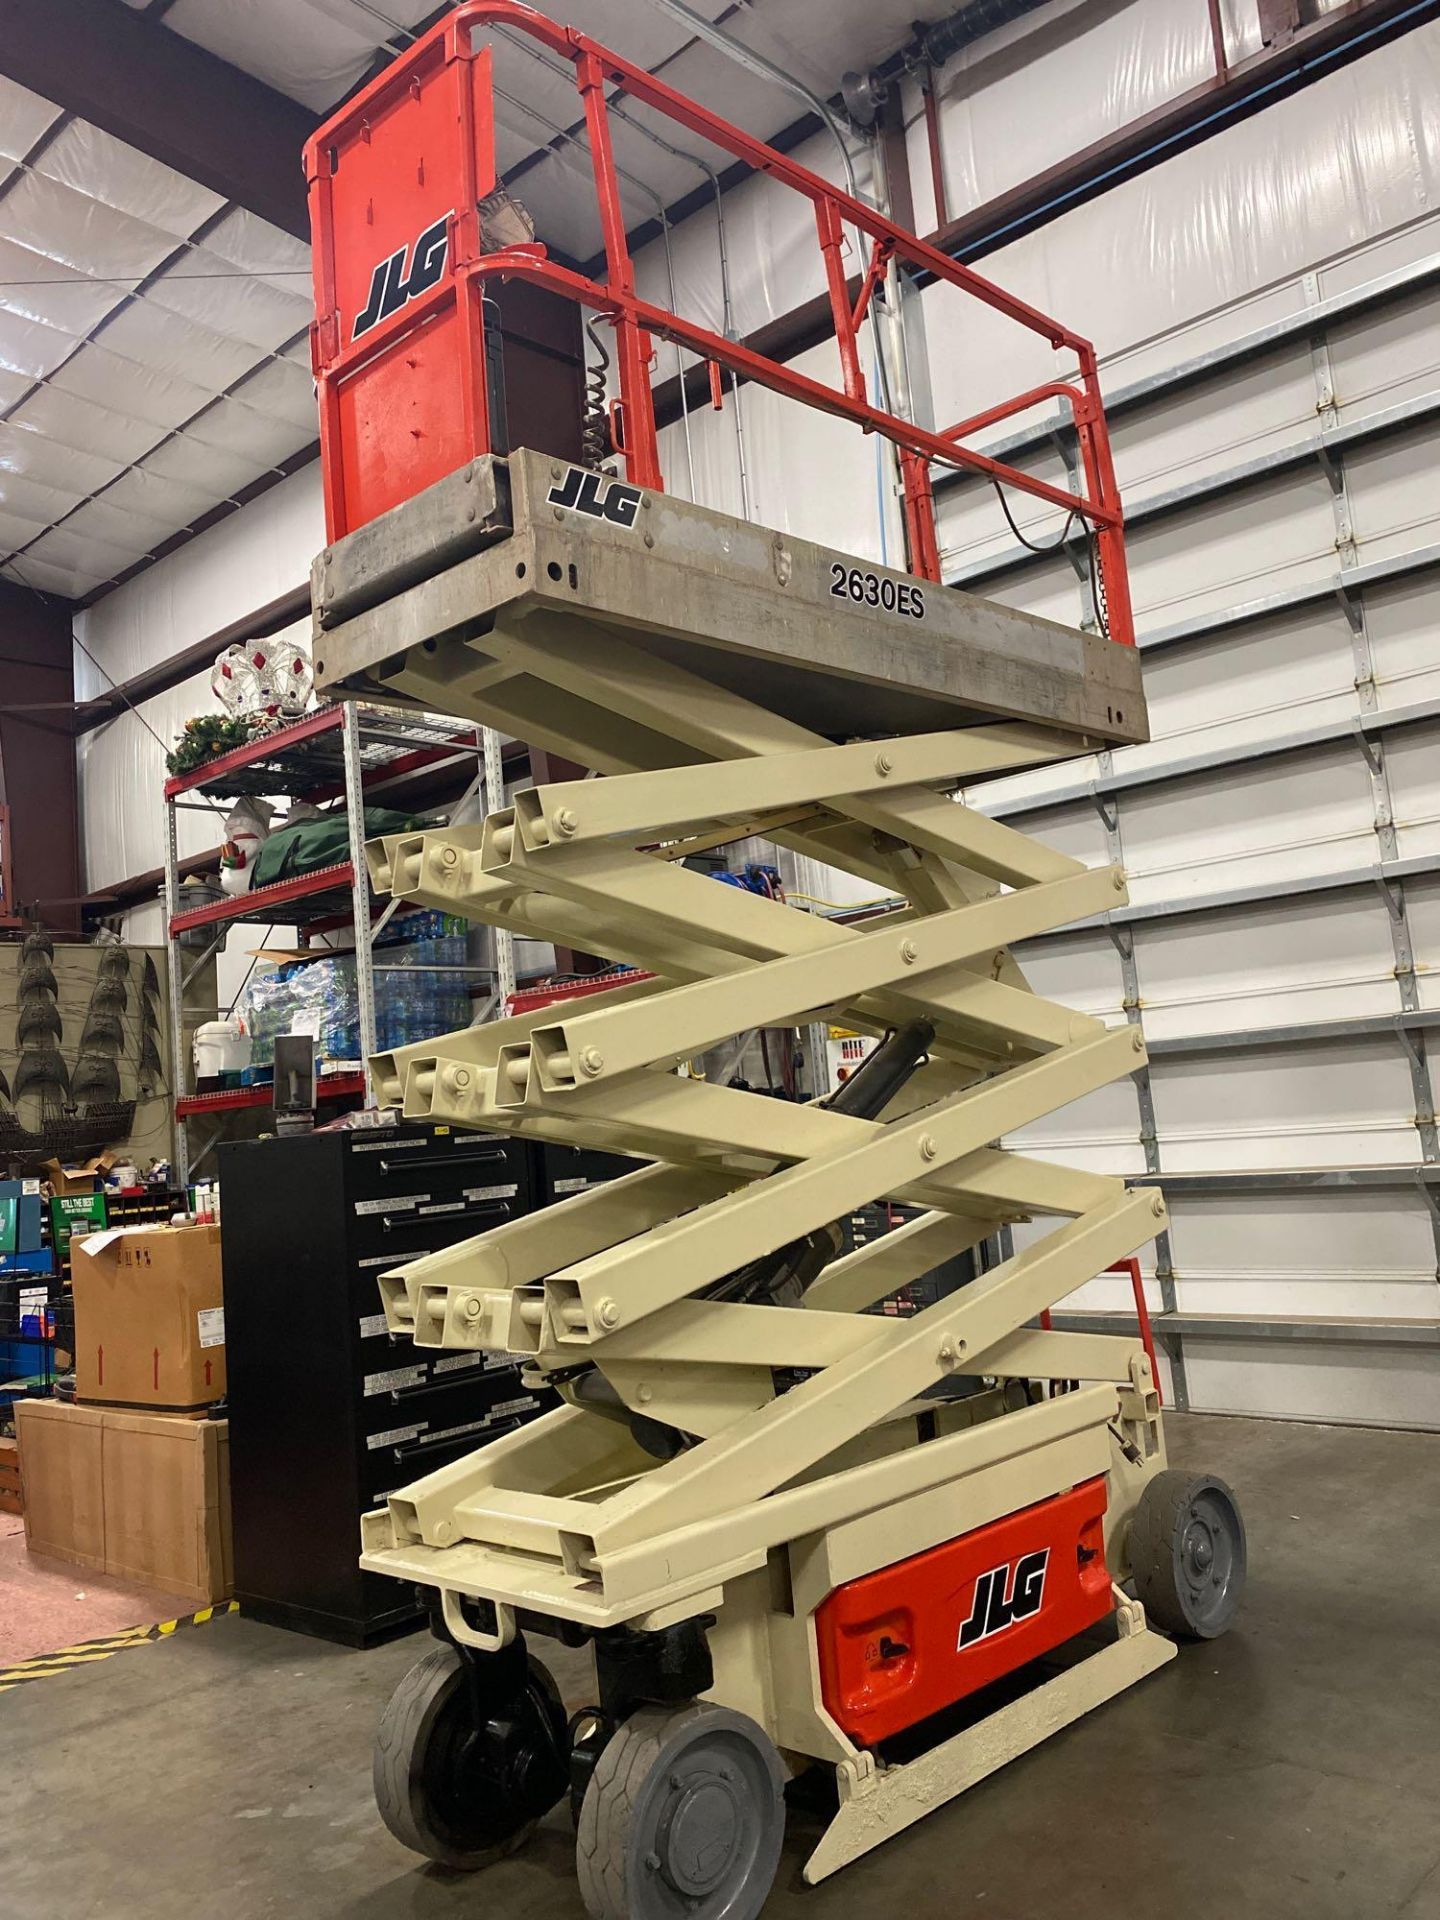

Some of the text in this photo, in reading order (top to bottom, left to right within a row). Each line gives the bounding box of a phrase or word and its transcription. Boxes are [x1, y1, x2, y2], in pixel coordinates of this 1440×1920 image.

[352, 209, 455, 343] JLG
[546, 466, 643, 530] JLG
[830, 562, 925, 620] 2630ES
[956, 1547, 1050, 1652] JLG
